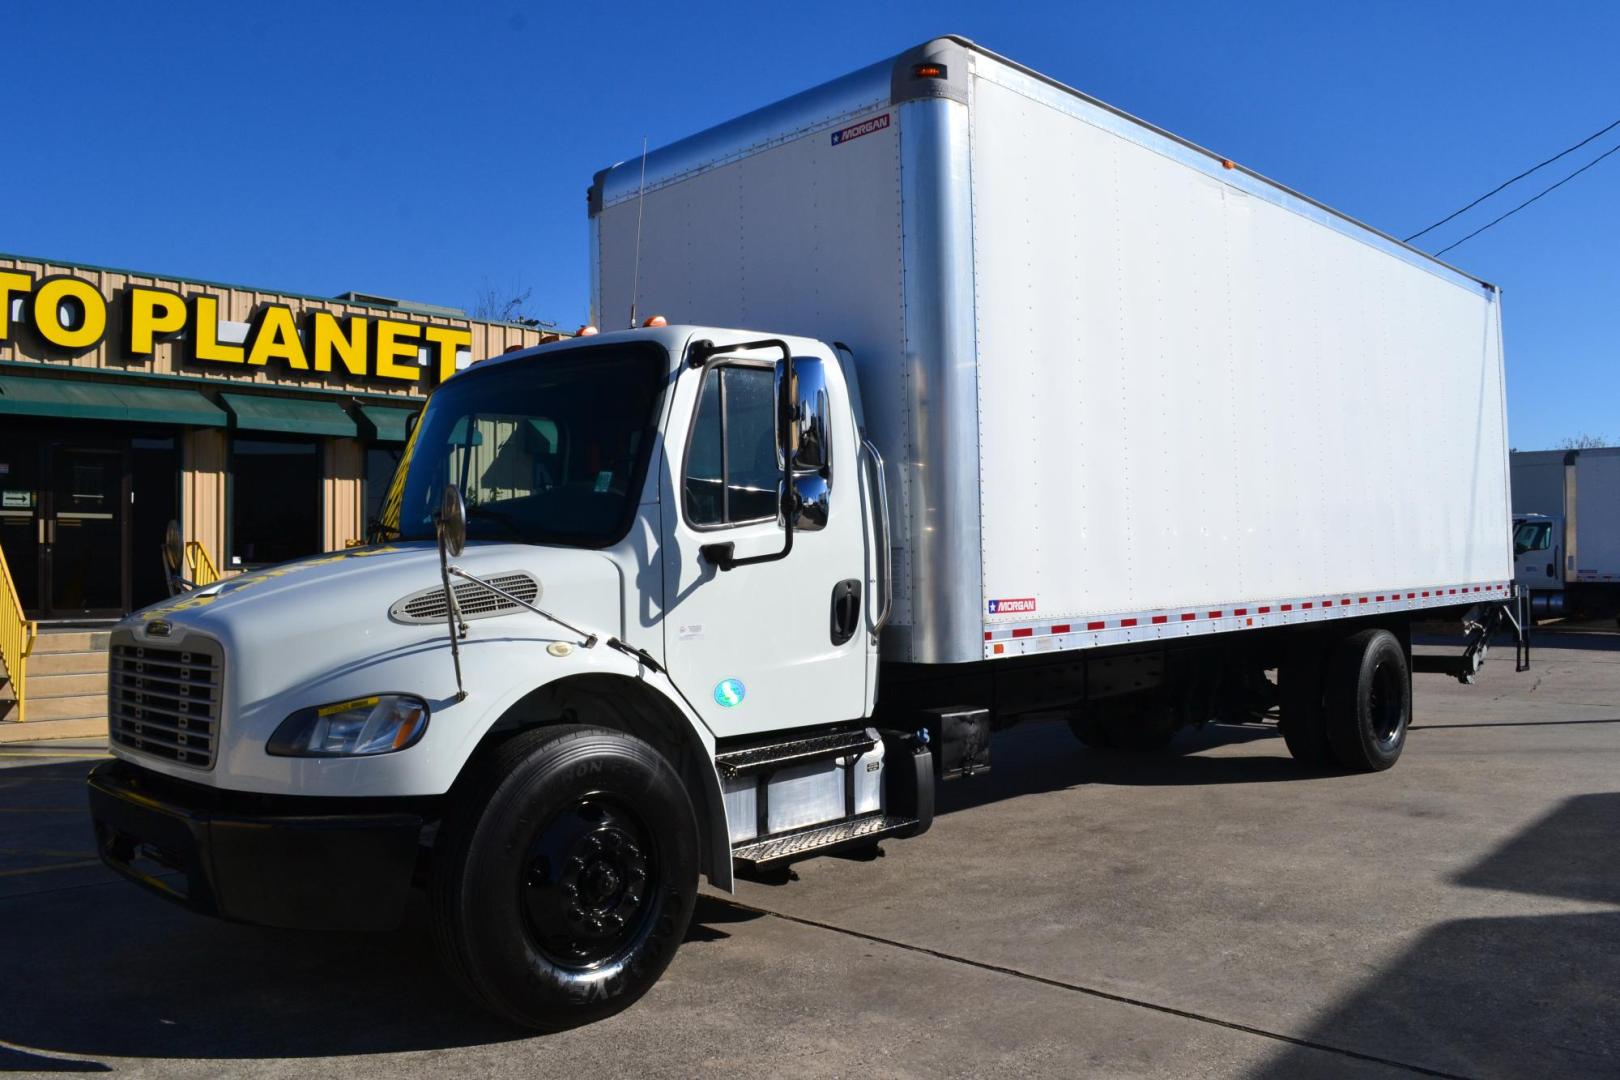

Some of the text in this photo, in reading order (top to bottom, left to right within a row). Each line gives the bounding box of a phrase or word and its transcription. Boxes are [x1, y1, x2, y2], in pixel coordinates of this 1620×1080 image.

[841, 116, 887, 140] MORGAN
[131, 288, 472, 384] PLANET
[997, 601, 1035, 612] MORGAN
